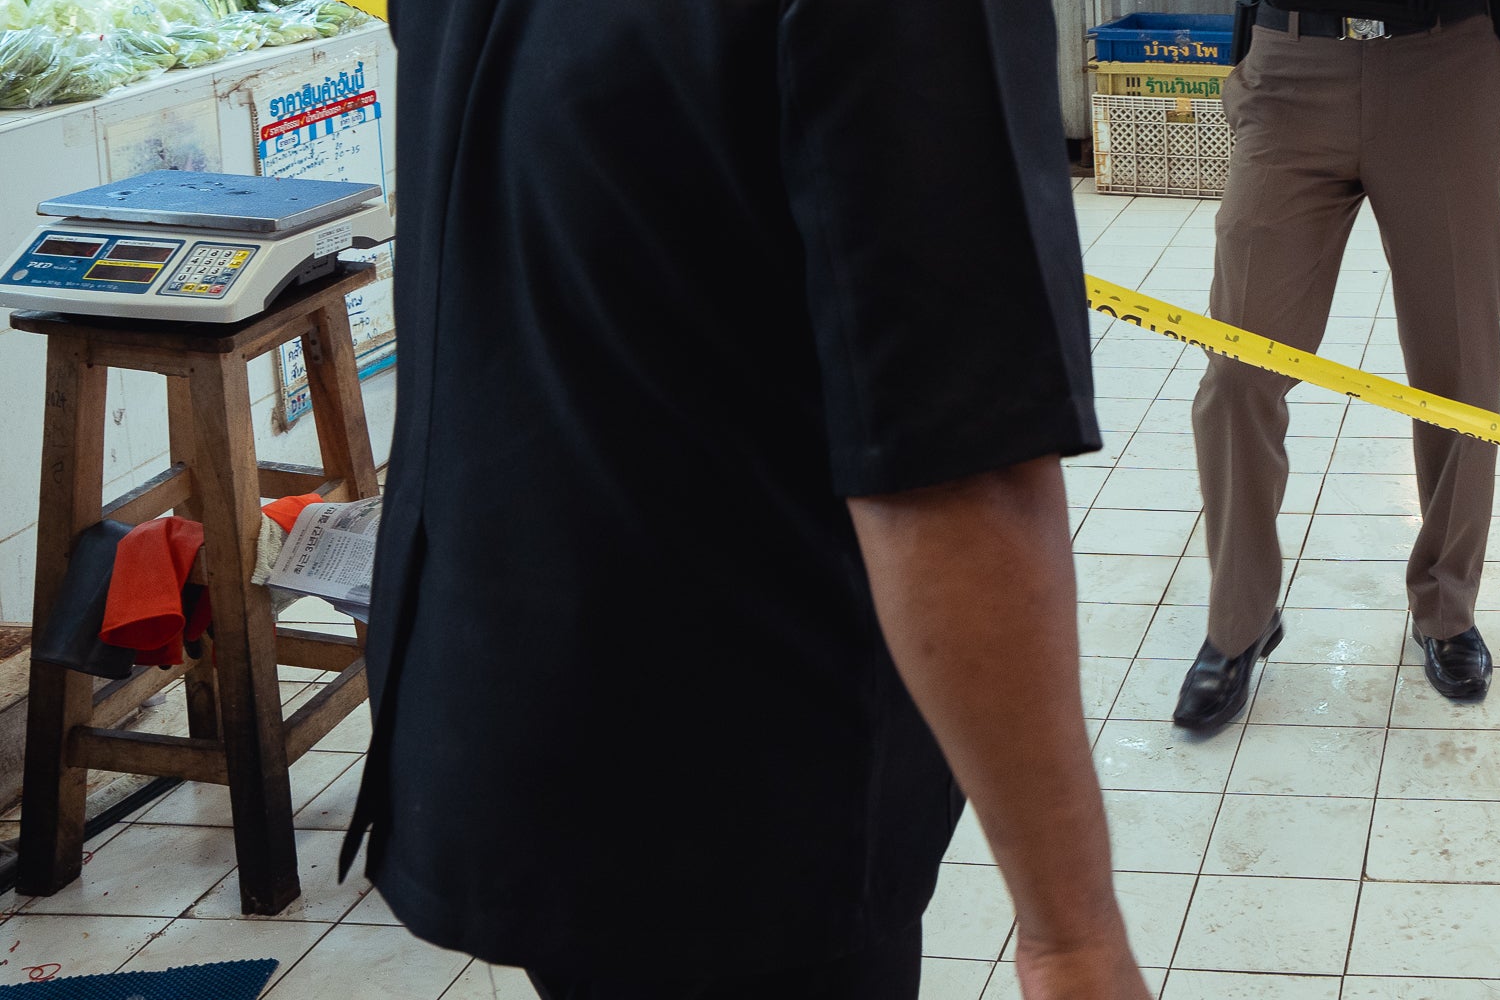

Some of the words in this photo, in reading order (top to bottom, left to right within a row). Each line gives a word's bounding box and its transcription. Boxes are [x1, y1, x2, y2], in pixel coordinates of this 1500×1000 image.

[1143, 40, 1190, 61] บำรุง
[269, 61, 365, 118] ราคาสินค้าวันนี้
